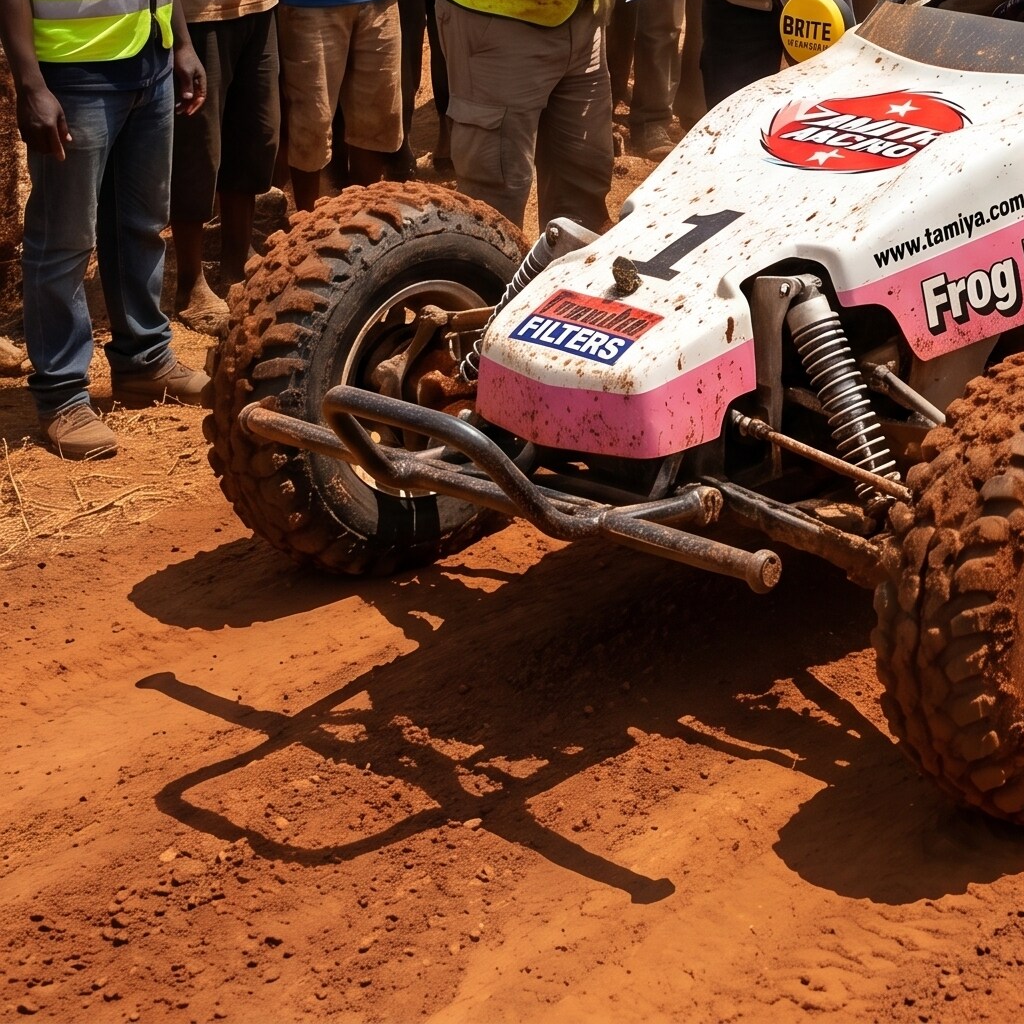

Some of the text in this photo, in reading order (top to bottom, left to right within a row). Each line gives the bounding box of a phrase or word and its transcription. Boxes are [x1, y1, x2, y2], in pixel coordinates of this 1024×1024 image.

[783, 15, 832, 42] BRITE
[631, 209, 746, 281] 1
[921, 258, 1020, 333] Frog
[517, 316, 626, 360] FILTERS
